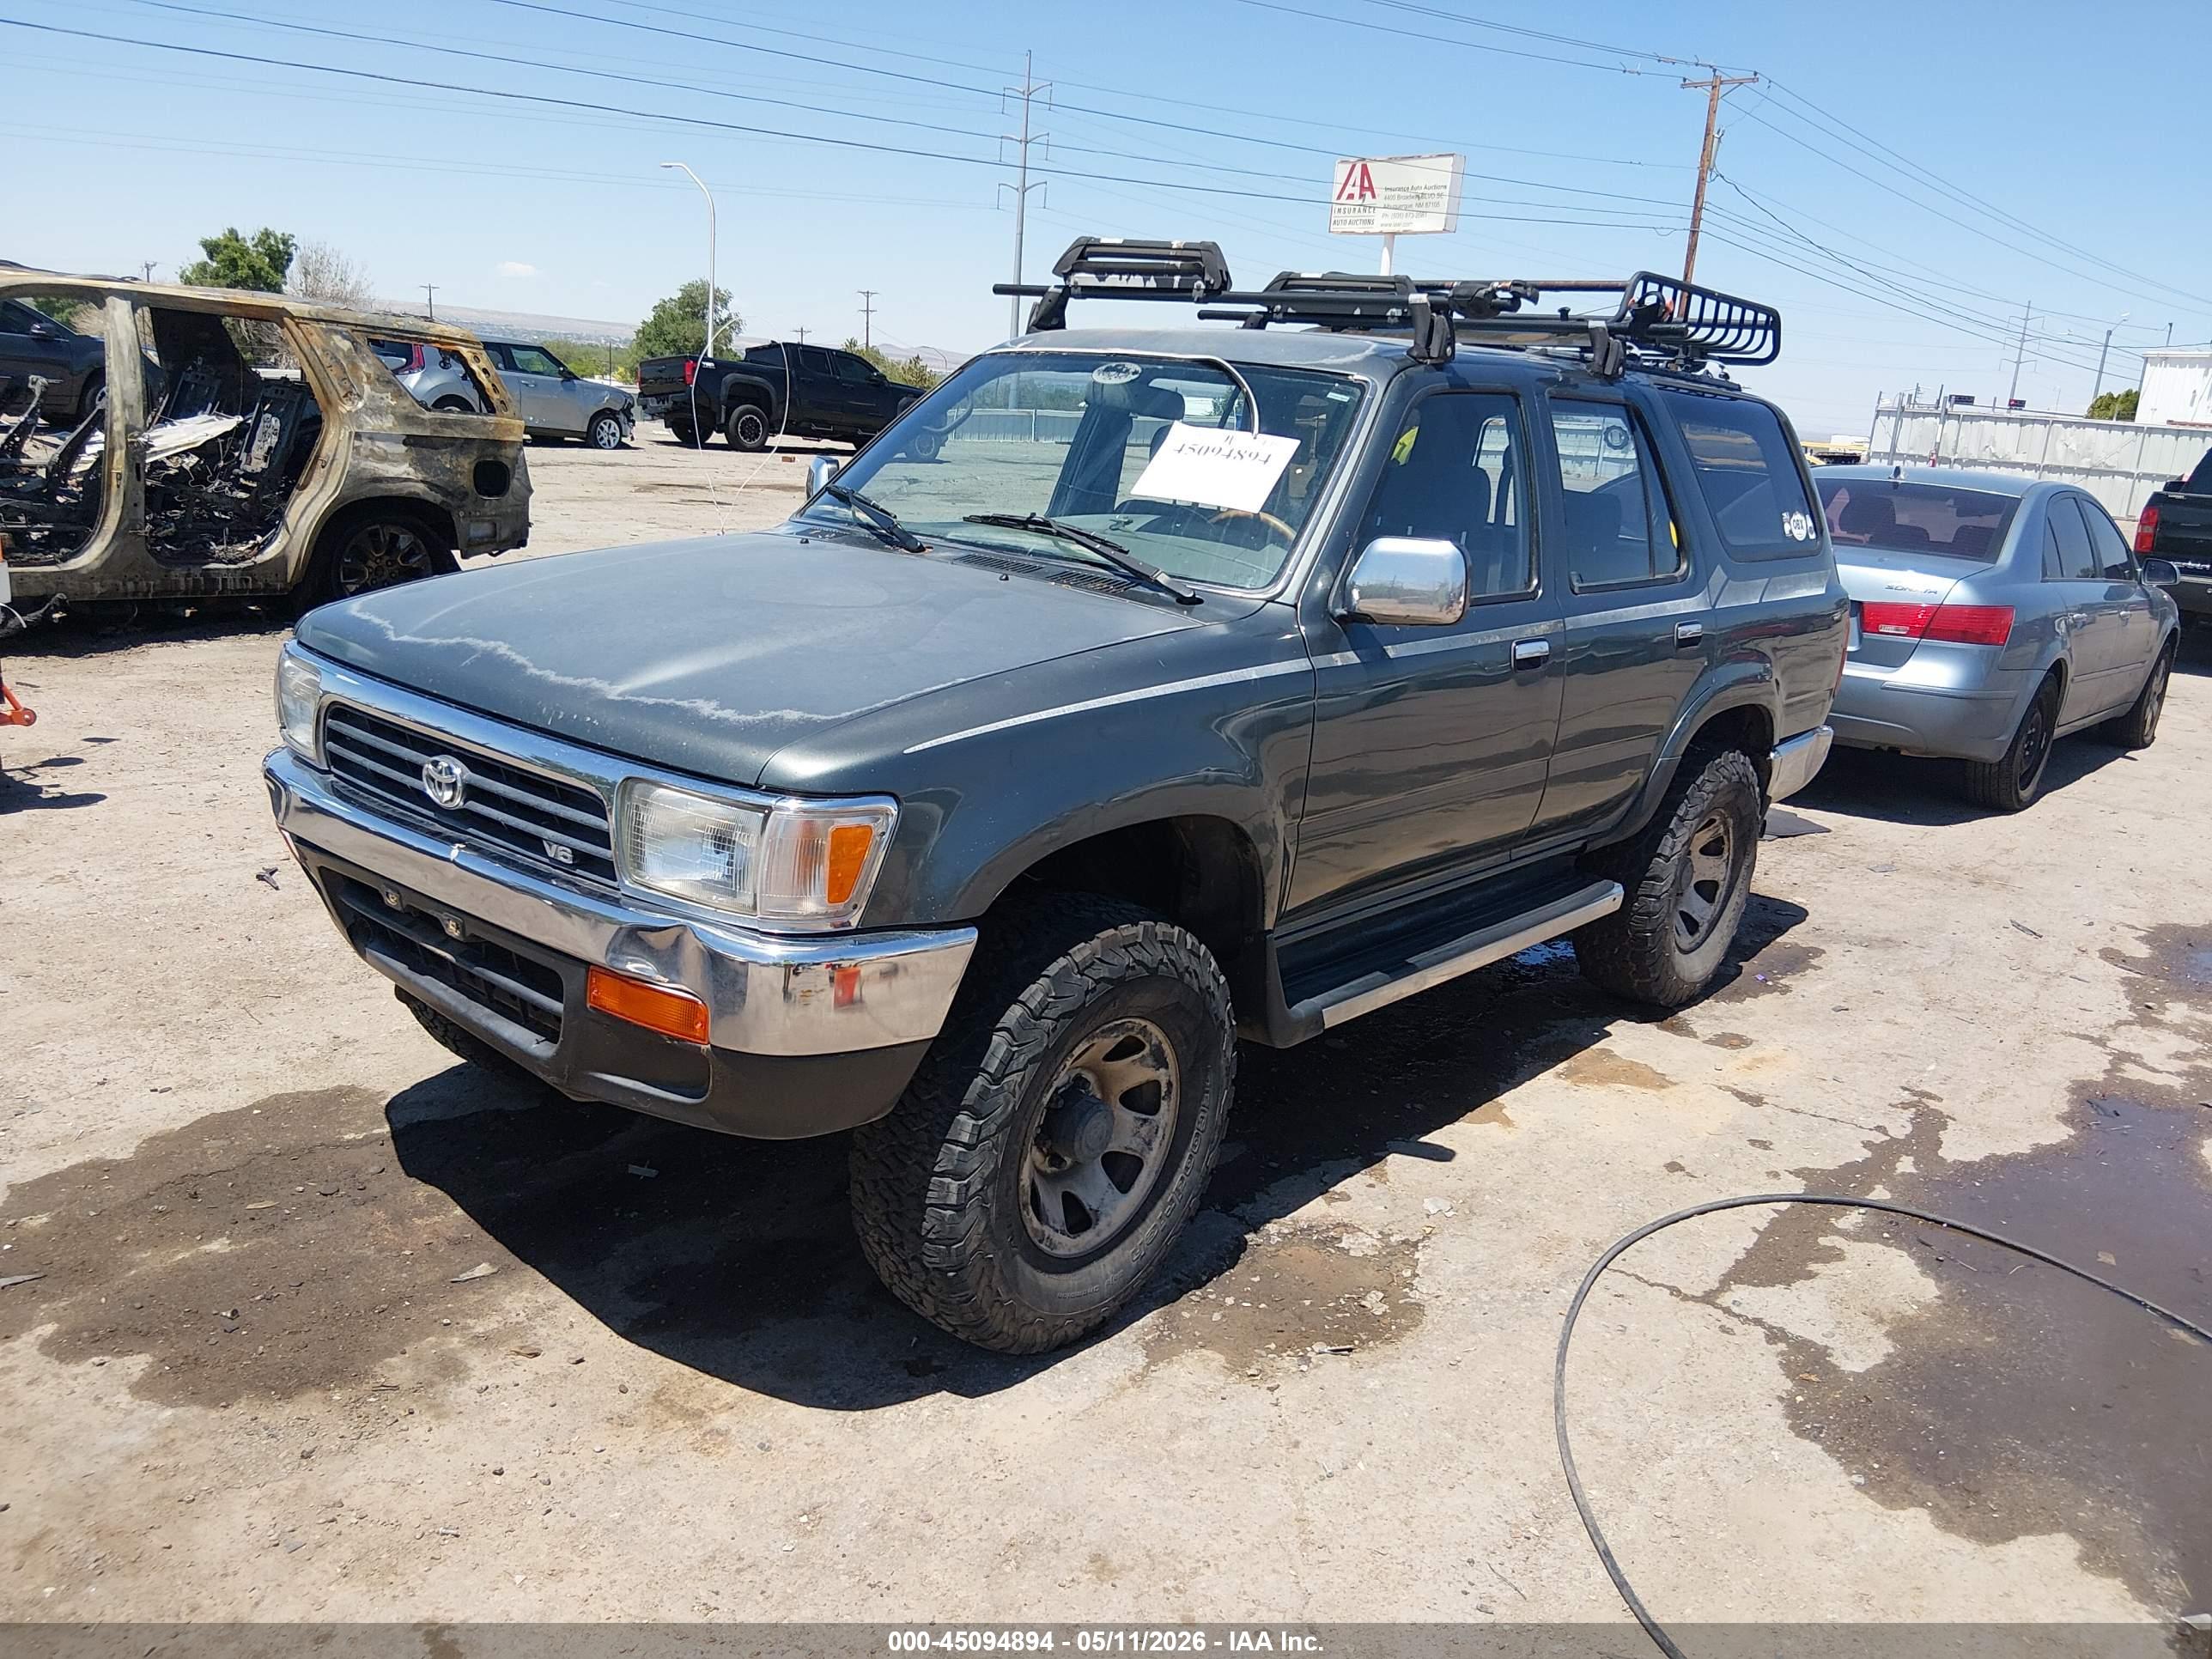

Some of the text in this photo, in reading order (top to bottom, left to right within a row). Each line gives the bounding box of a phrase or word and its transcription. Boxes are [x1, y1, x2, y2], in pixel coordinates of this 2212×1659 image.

[1334, 206, 1376, 215] INSURANCE
[1884, 584, 1938, 595] SONTA
[543, 839, 574, 865] V6
